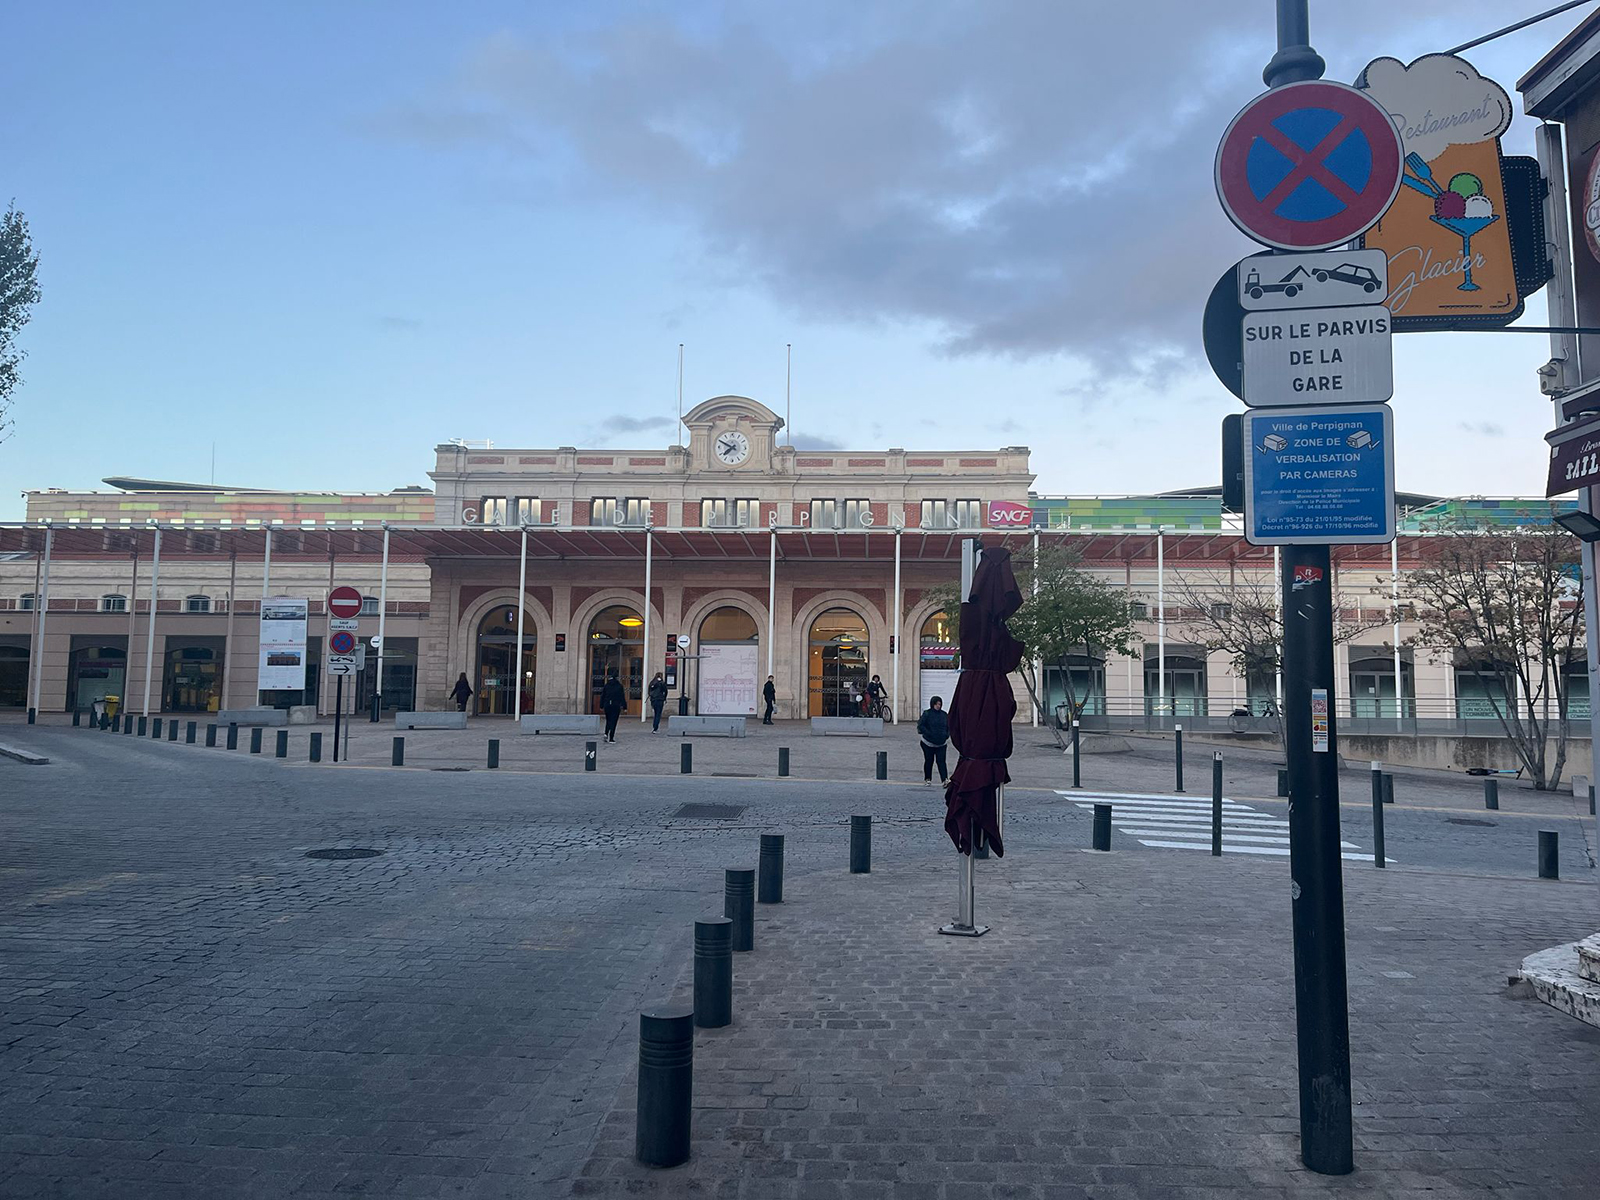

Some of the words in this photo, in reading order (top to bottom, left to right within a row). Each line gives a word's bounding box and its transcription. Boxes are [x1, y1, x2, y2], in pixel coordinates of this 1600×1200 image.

[1246, 326, 1283, 341] SUR
[1290, 323, 1311, 338] LE
[1317, 318, 1388, 337] PARVIS
[1290, 350, 1314, 365] DE
[1320, 348, 1343, 364] LA
[1292, 375, 1343, 392] GARE
[1272, 422, 1293, 431] Ville
[1296, 421, 1308, 431] de
[1311, 421, 1363, 432] Perpignan
[1293, 438, 1323, 448] ZONE
[1326, 437, 1341, 447] DE
[1275, 453, 1361, 464] VERBALISATION
[1280, 470, 1301, 480] PAR
[1304, 469, 1358, 479] CAMERAS
[462, 507, 560, 526] GARE
[614, 508, 654, 526] DE
[709, 510, 961, 528] PERPIGNAN
[990, 510, 1031, 522] SNCF
